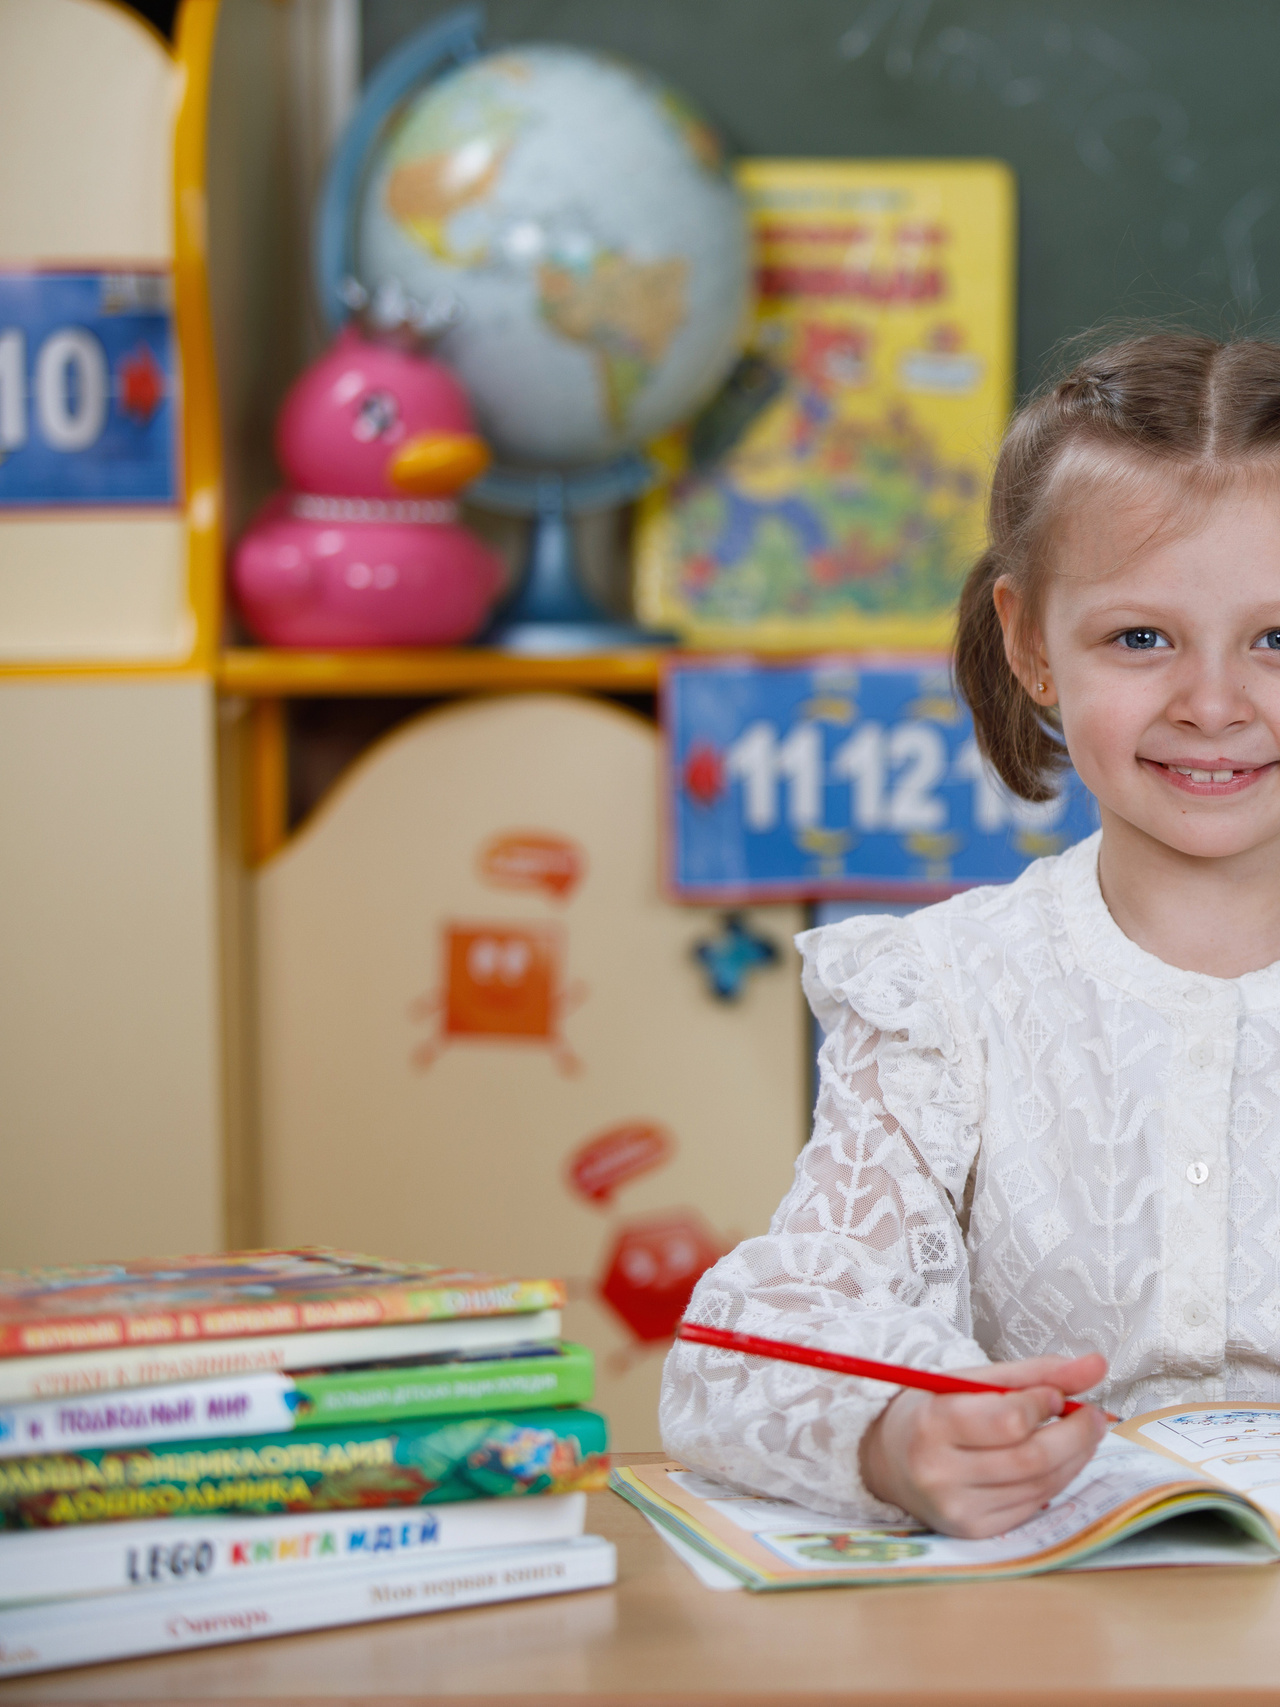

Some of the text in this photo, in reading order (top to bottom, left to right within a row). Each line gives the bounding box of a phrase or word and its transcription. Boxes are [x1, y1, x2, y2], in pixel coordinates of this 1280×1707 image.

[0, 323, 110, 453] 10
[728, 720, 824, 832] 11
[834, 720, 948, 832] 12
[58, 1401, 197, 1434] ПОДВОДНЫЙ
[207, 1392, 250, 1419] МИР
[128, 1437, 396, 1483] ЭНЦИКЛОПЕДИЯ
[48, 1476, 313, 1524] ДОШКОЛЬНИКА
[127, 1512, 441, 1586] LEGO КНИГА ИДЕЙ
